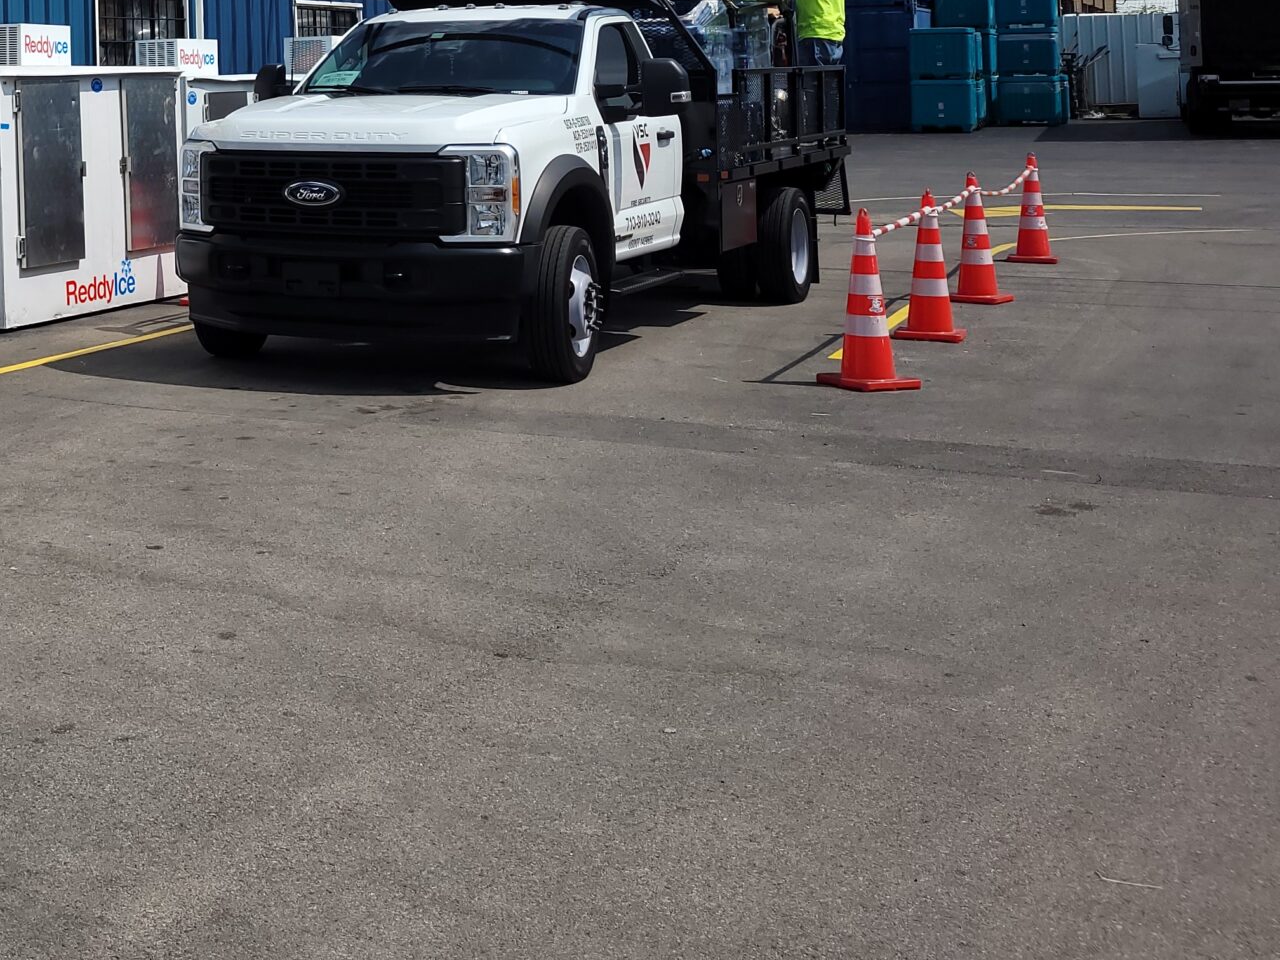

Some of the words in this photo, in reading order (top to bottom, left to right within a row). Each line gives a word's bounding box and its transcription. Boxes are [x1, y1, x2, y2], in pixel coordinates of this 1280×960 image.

[240, 130, 326, 140] SUPER
[332, 131, 408, 140] DUTY
[633, 123, 649, 138] VSC
[296, 187, 327, 200] Ford
[66, 272, 136, 306] ReddyIce
